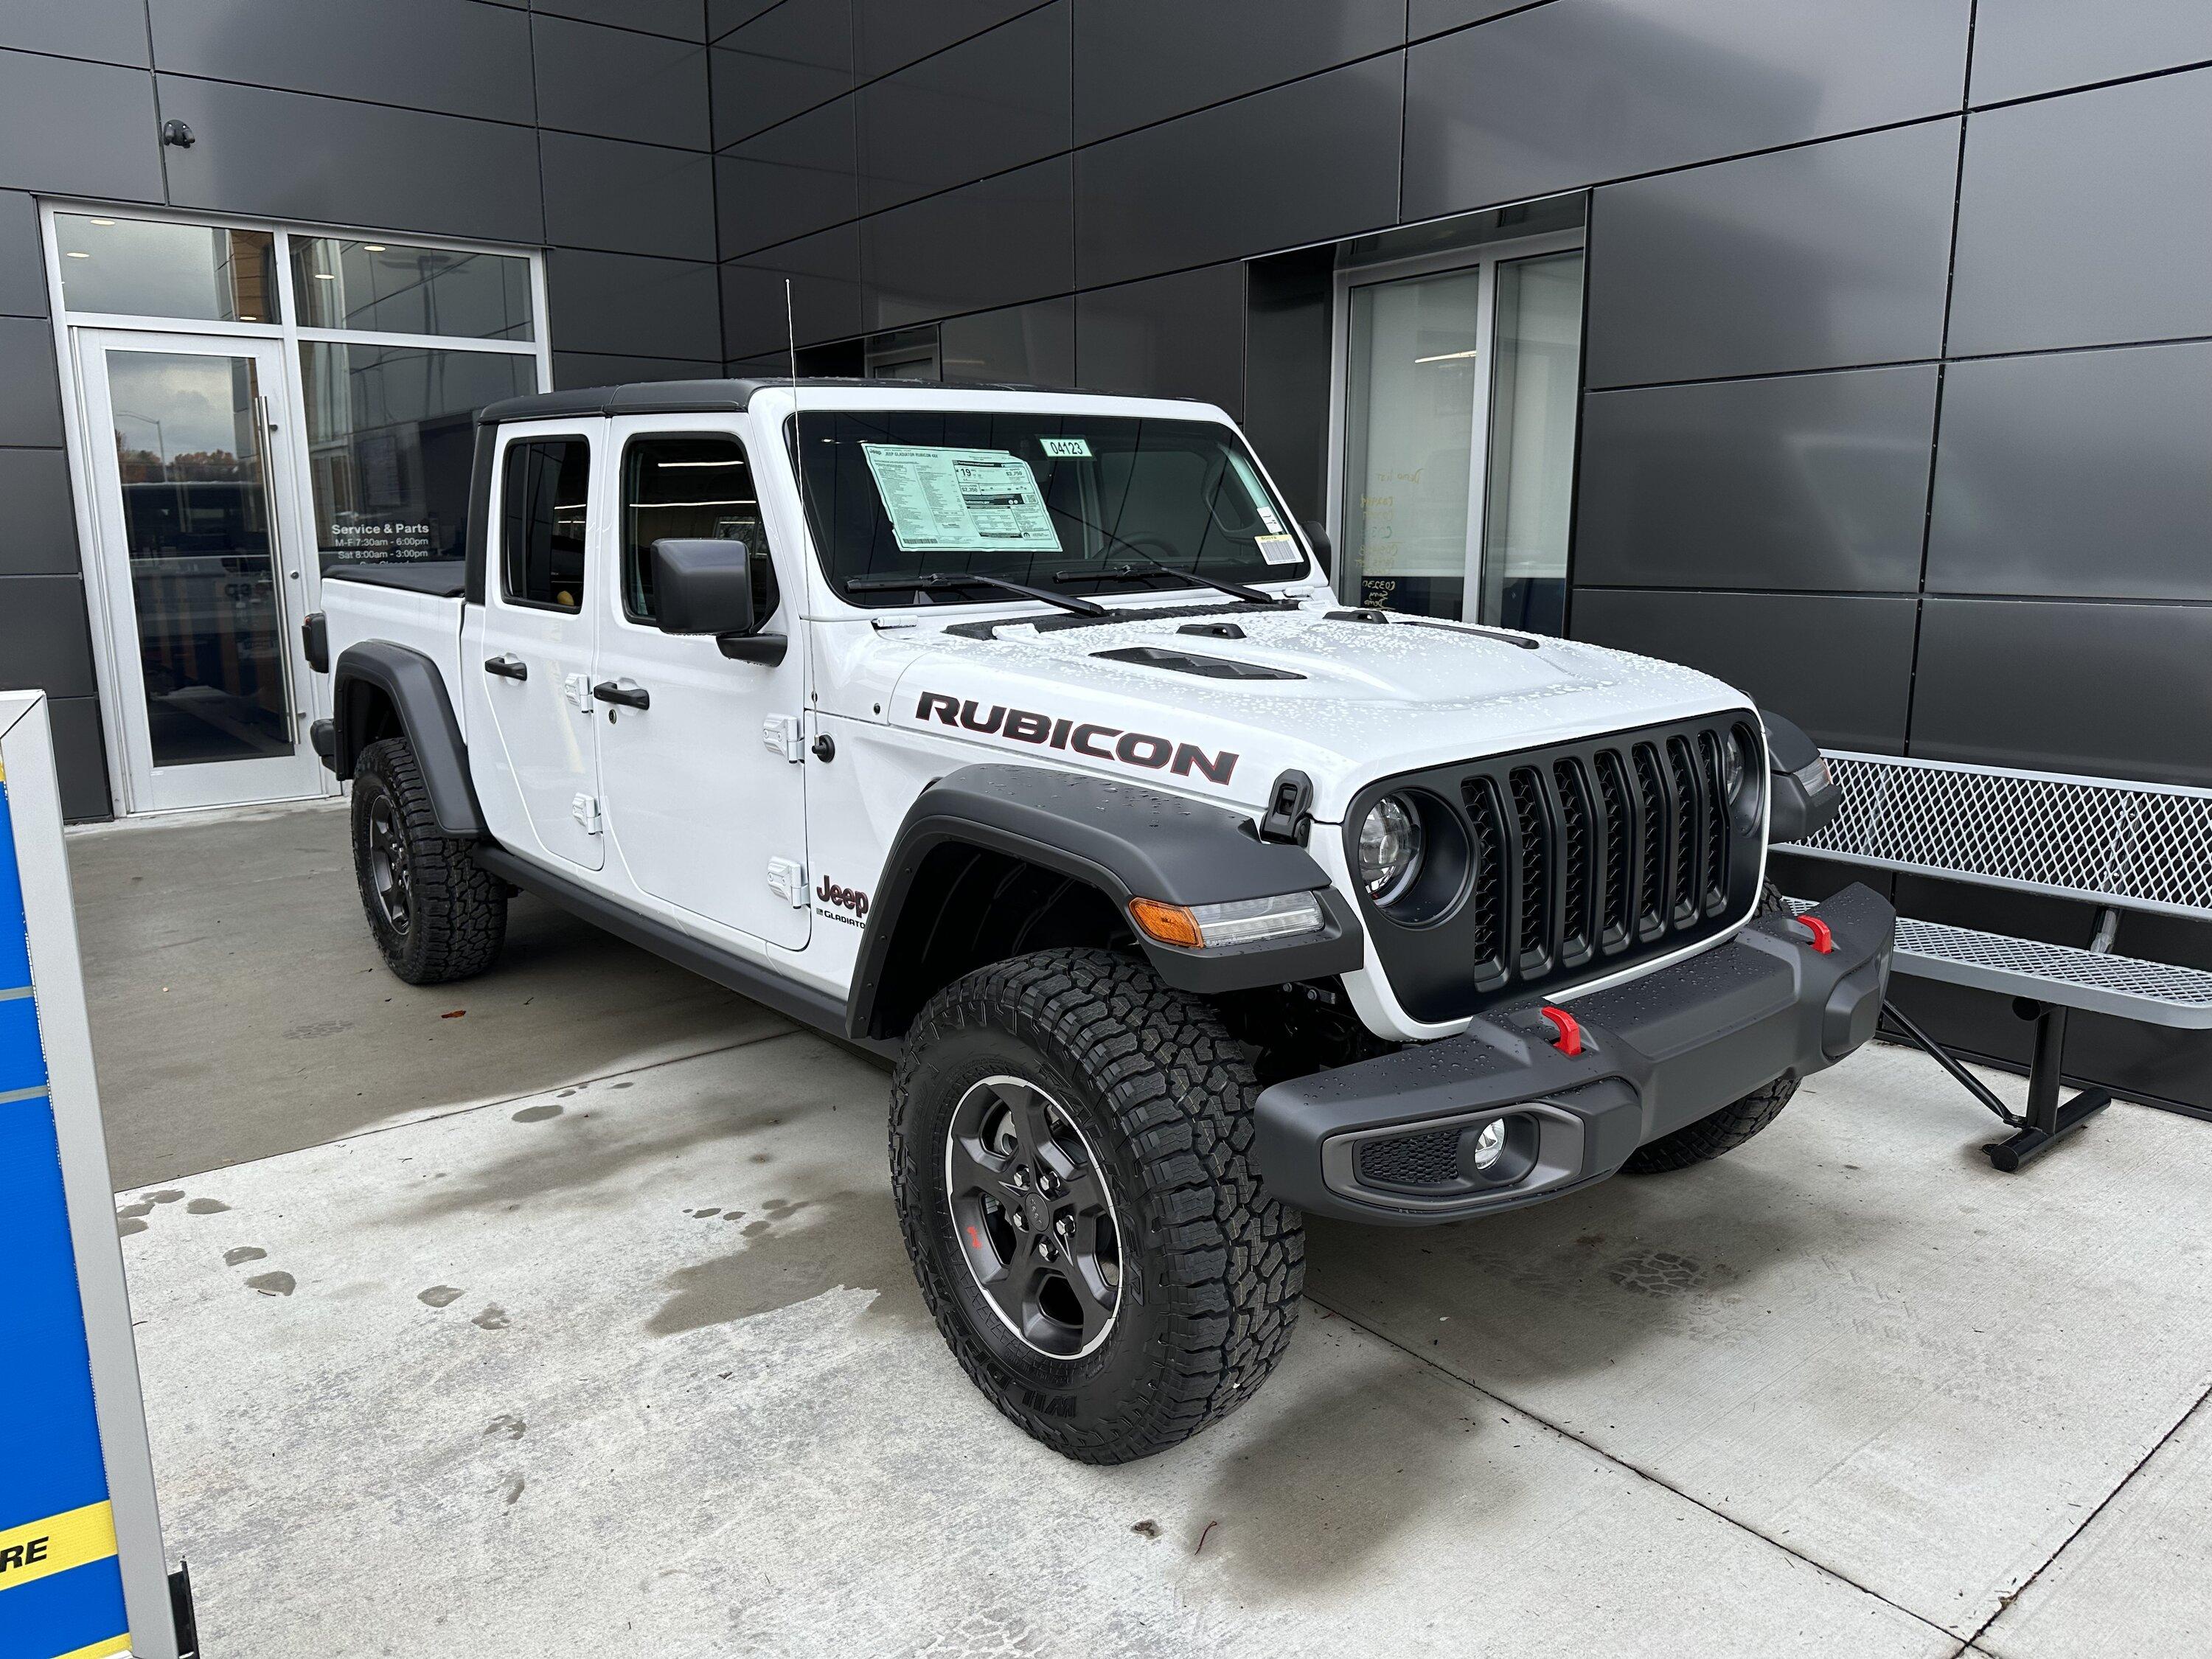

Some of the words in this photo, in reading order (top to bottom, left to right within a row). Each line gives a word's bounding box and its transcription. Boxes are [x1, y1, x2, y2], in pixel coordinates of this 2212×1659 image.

[1050, 442, 1083, 454] 04123
[961, 468, 972, 477] 19
[331, 524, 380, 535] Service
[383, 524, 393, 534] &
[396, 524, 429, 534] Parts
[335, 539, 354, 547] M-F
[356, 538, 389, 546] 7:30am
[396, 538, 429, 547] 6:00pm
[338, 551, 354, 560] Sat
[355, 551, 389, 559] 8:00am
[396, 550, 428, 558] 3:00pm
[915, 691, 1239, 786] RUBICON
[816, 874, 869, 919] Jeep
[824, 911, 866, 929] GLADIATO
[1034, 1058, 1145, 1307] FALKEN
